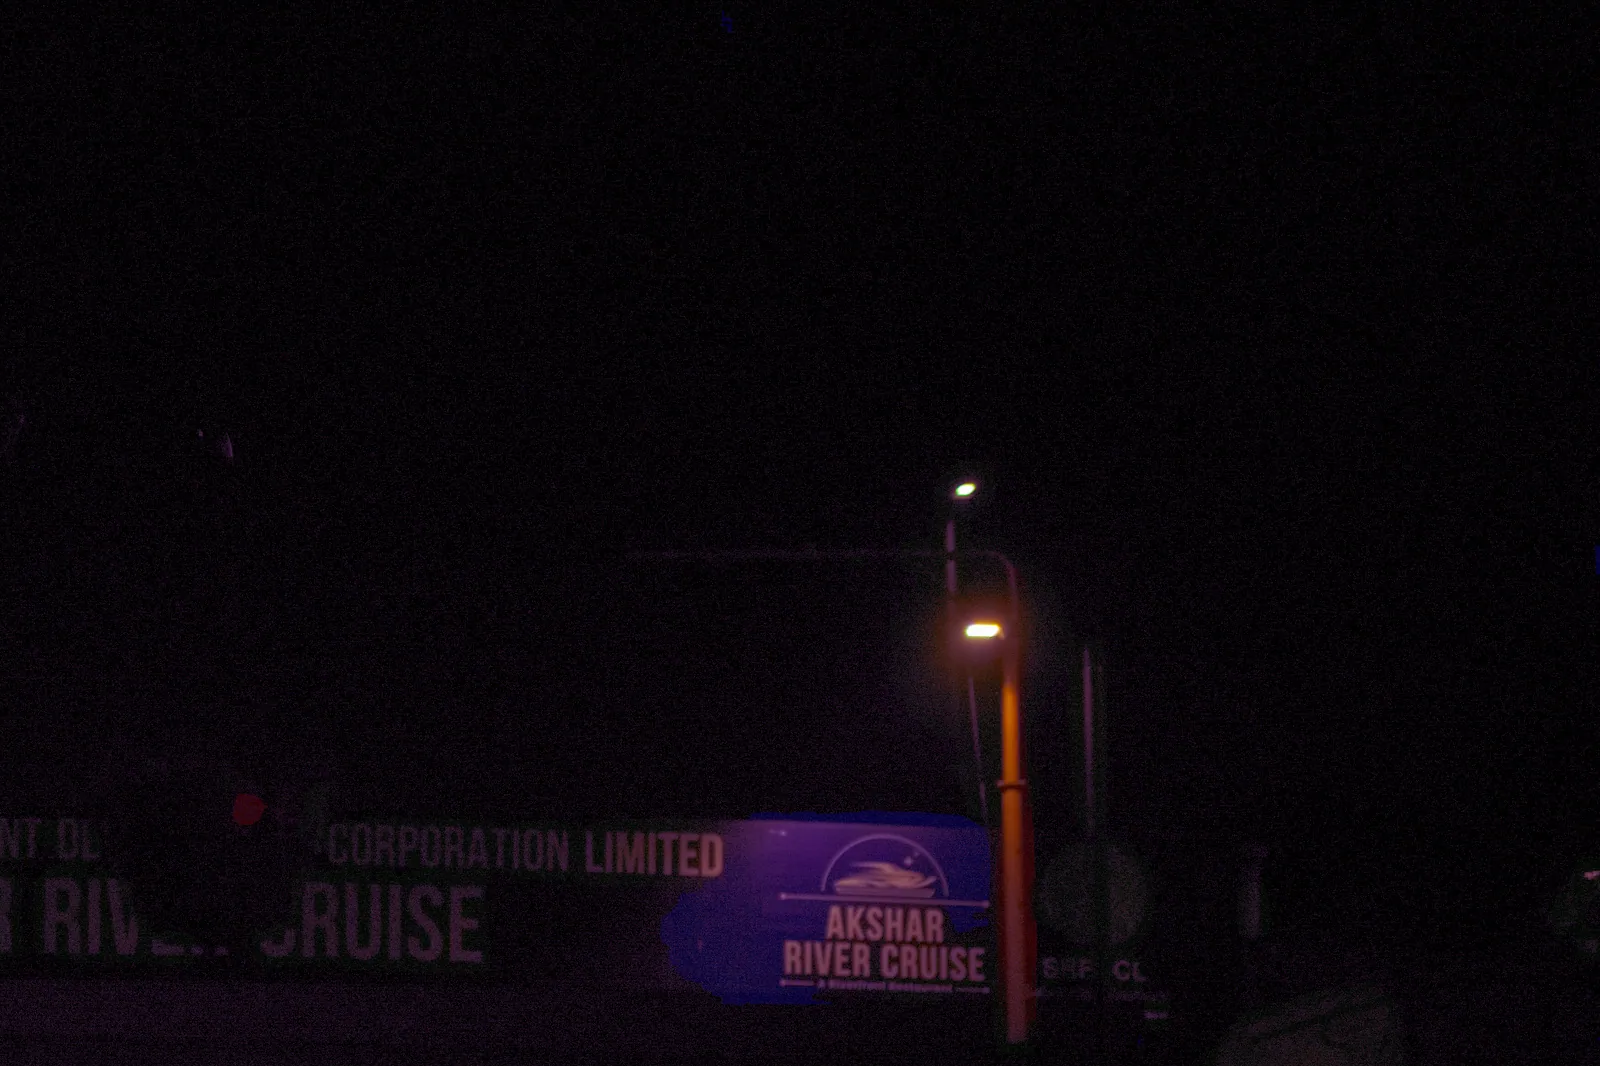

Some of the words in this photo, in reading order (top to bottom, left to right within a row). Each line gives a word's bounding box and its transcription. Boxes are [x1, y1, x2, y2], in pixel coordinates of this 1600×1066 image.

[328, 822, 568, 873] CORPORATION
[585, 830, 724, 878] LIMITED
[43, 876, 229, 956] RIV
[825, 904, 944, 944] AKSHAR
[784, 939, 871, 977] RIVER
[880, 943, 986, 983] CRUISE
